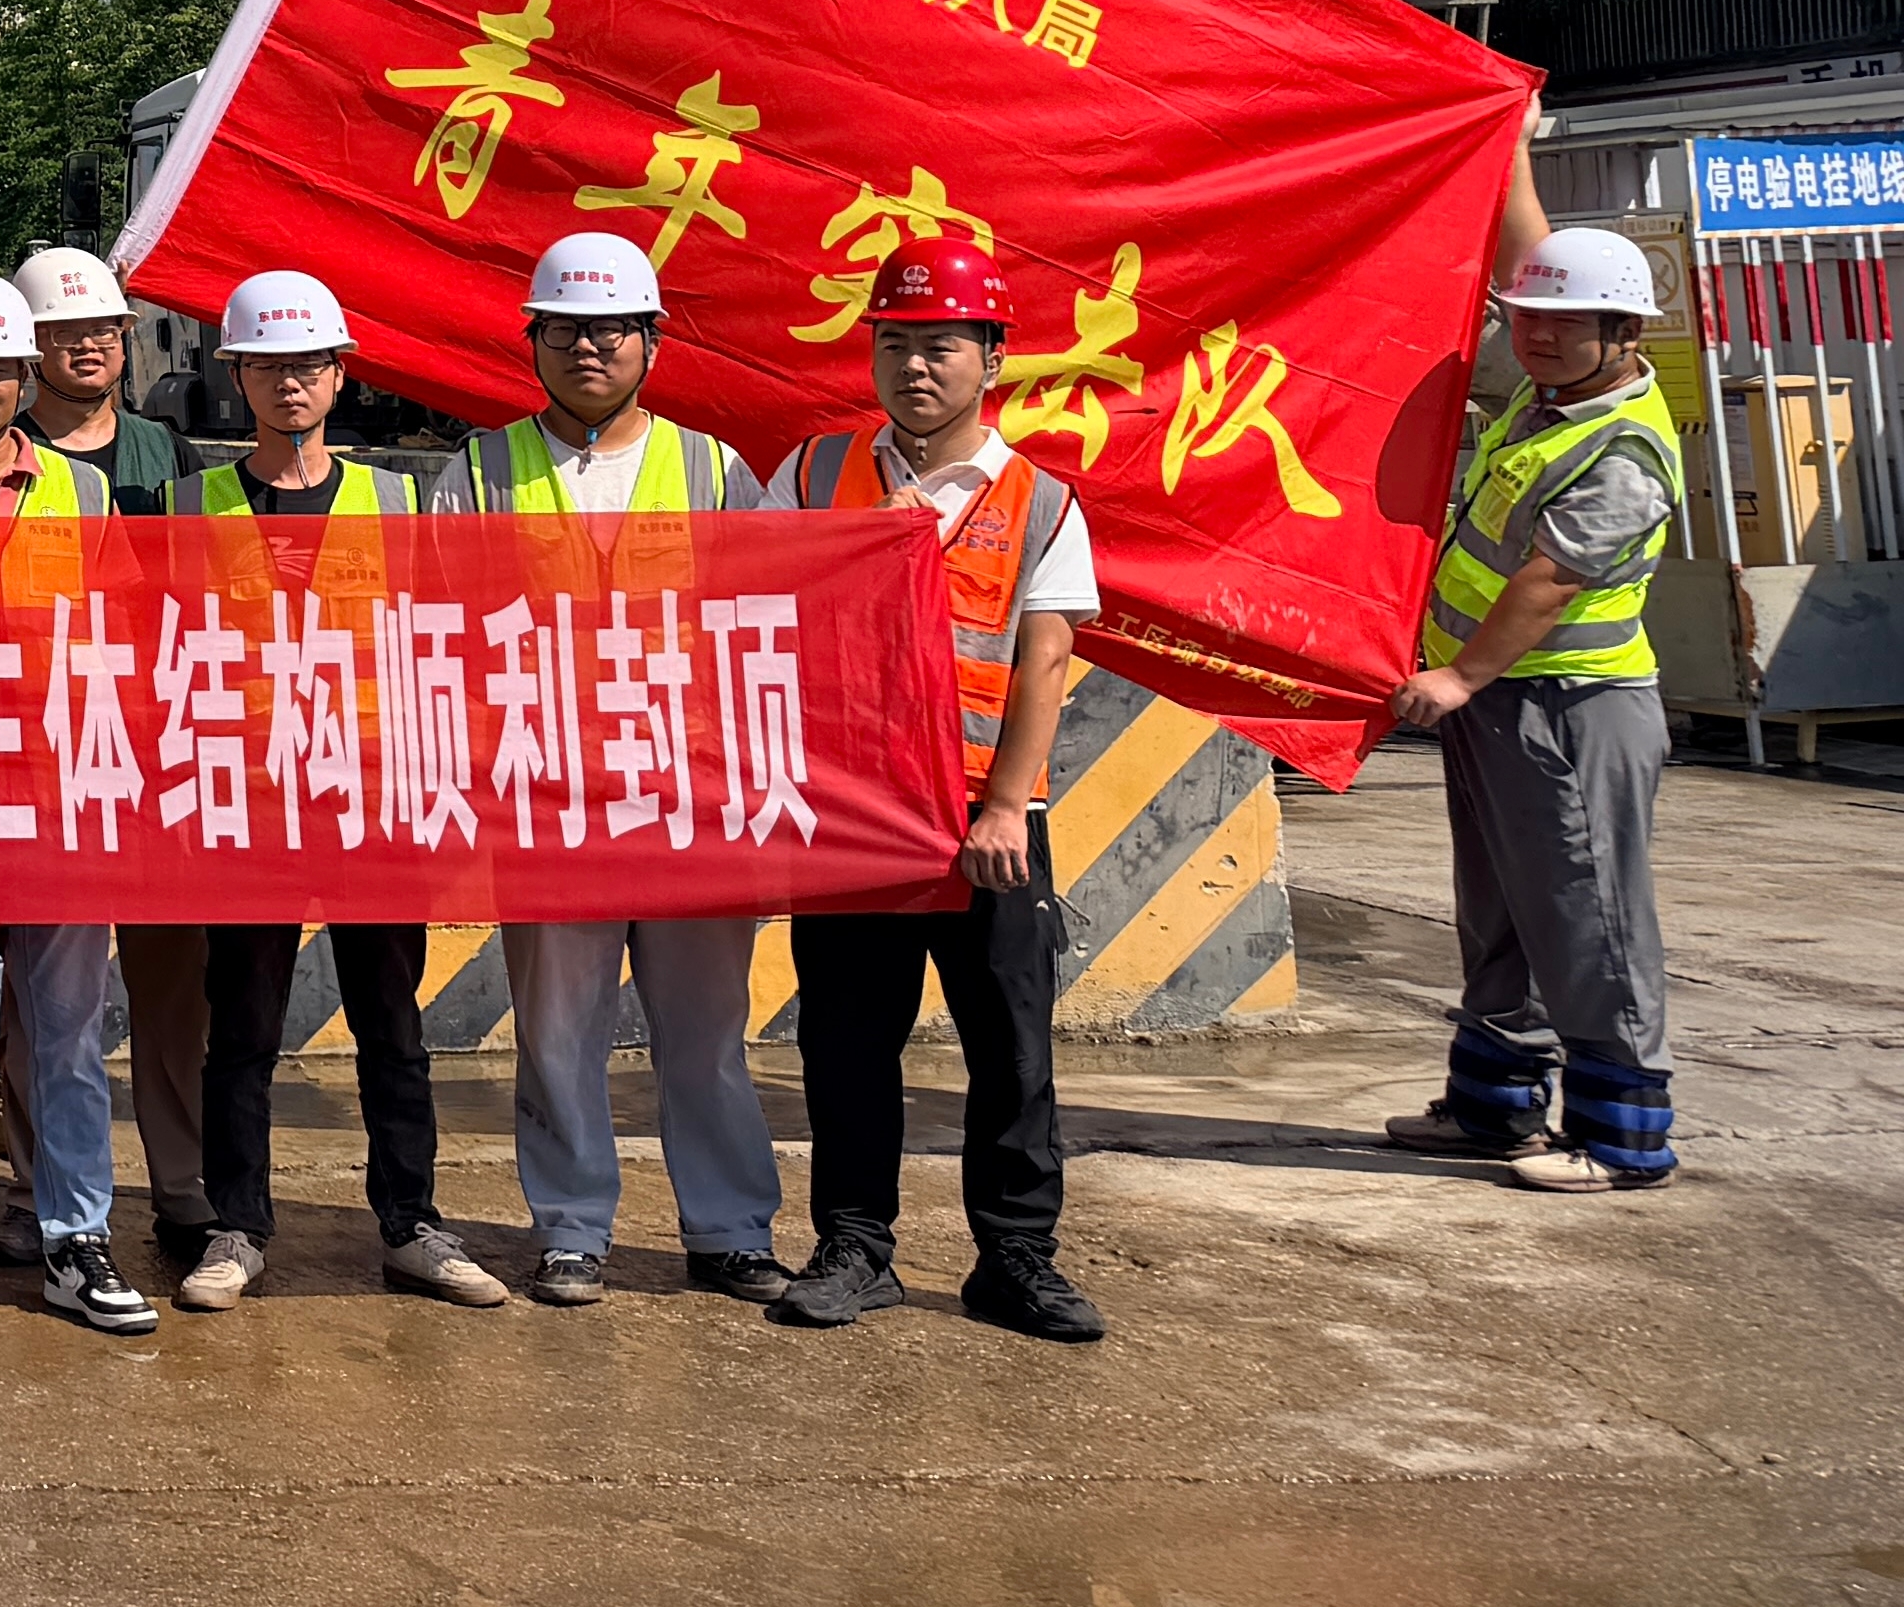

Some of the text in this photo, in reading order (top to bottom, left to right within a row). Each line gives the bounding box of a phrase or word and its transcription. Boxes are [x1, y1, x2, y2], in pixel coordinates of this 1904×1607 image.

[1705, 149, 1904, 212] 停电验电挂地线
